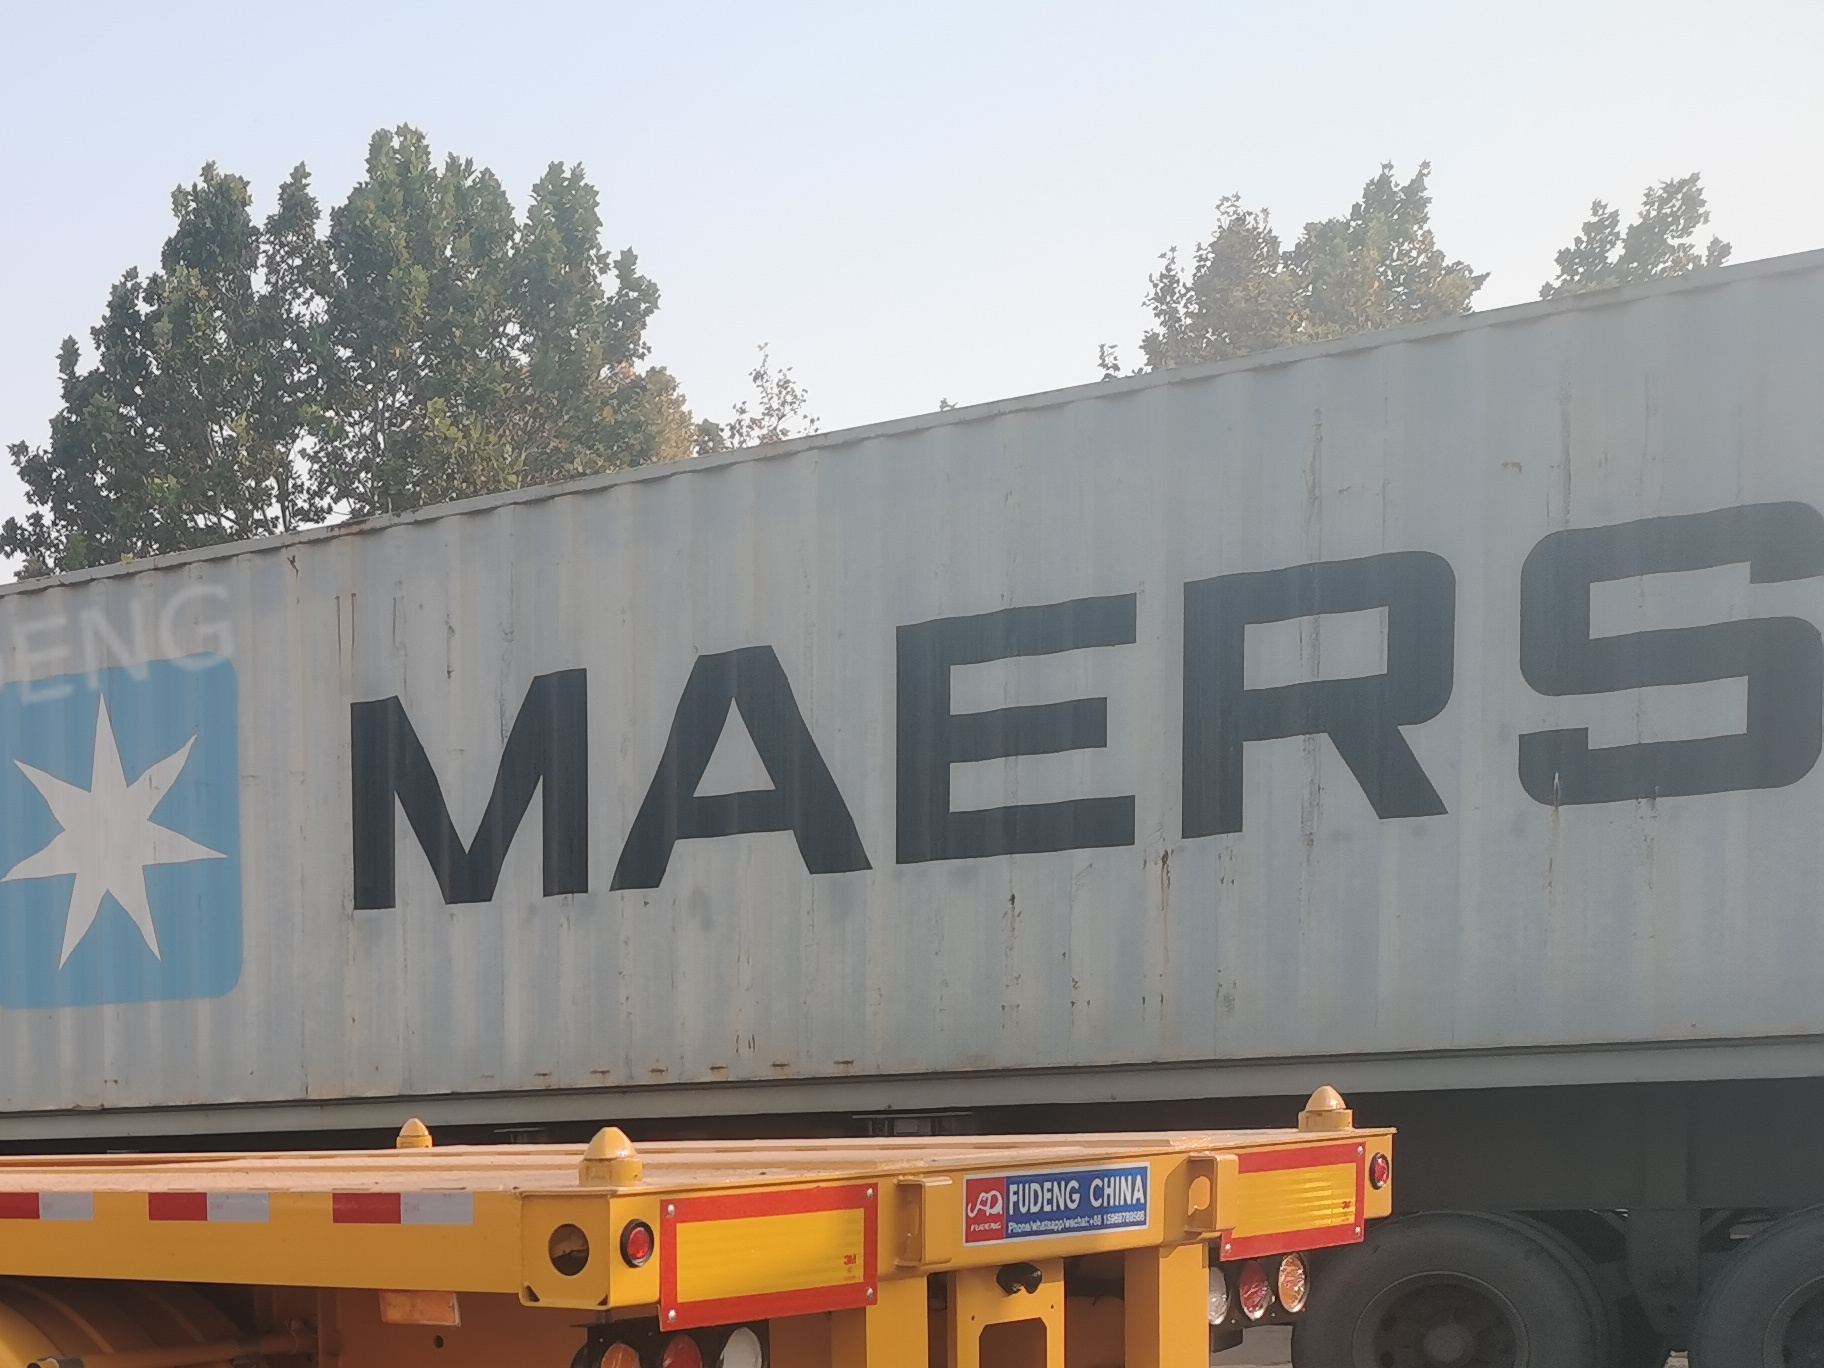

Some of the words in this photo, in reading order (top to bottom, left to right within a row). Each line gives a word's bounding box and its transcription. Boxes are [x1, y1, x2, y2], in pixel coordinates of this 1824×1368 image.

[351, 501, 1824, 910] MAERS
[1009, 1179, 1080, 1216] FUDENG
[1089, 1174, 1145, 1208] CHINA
